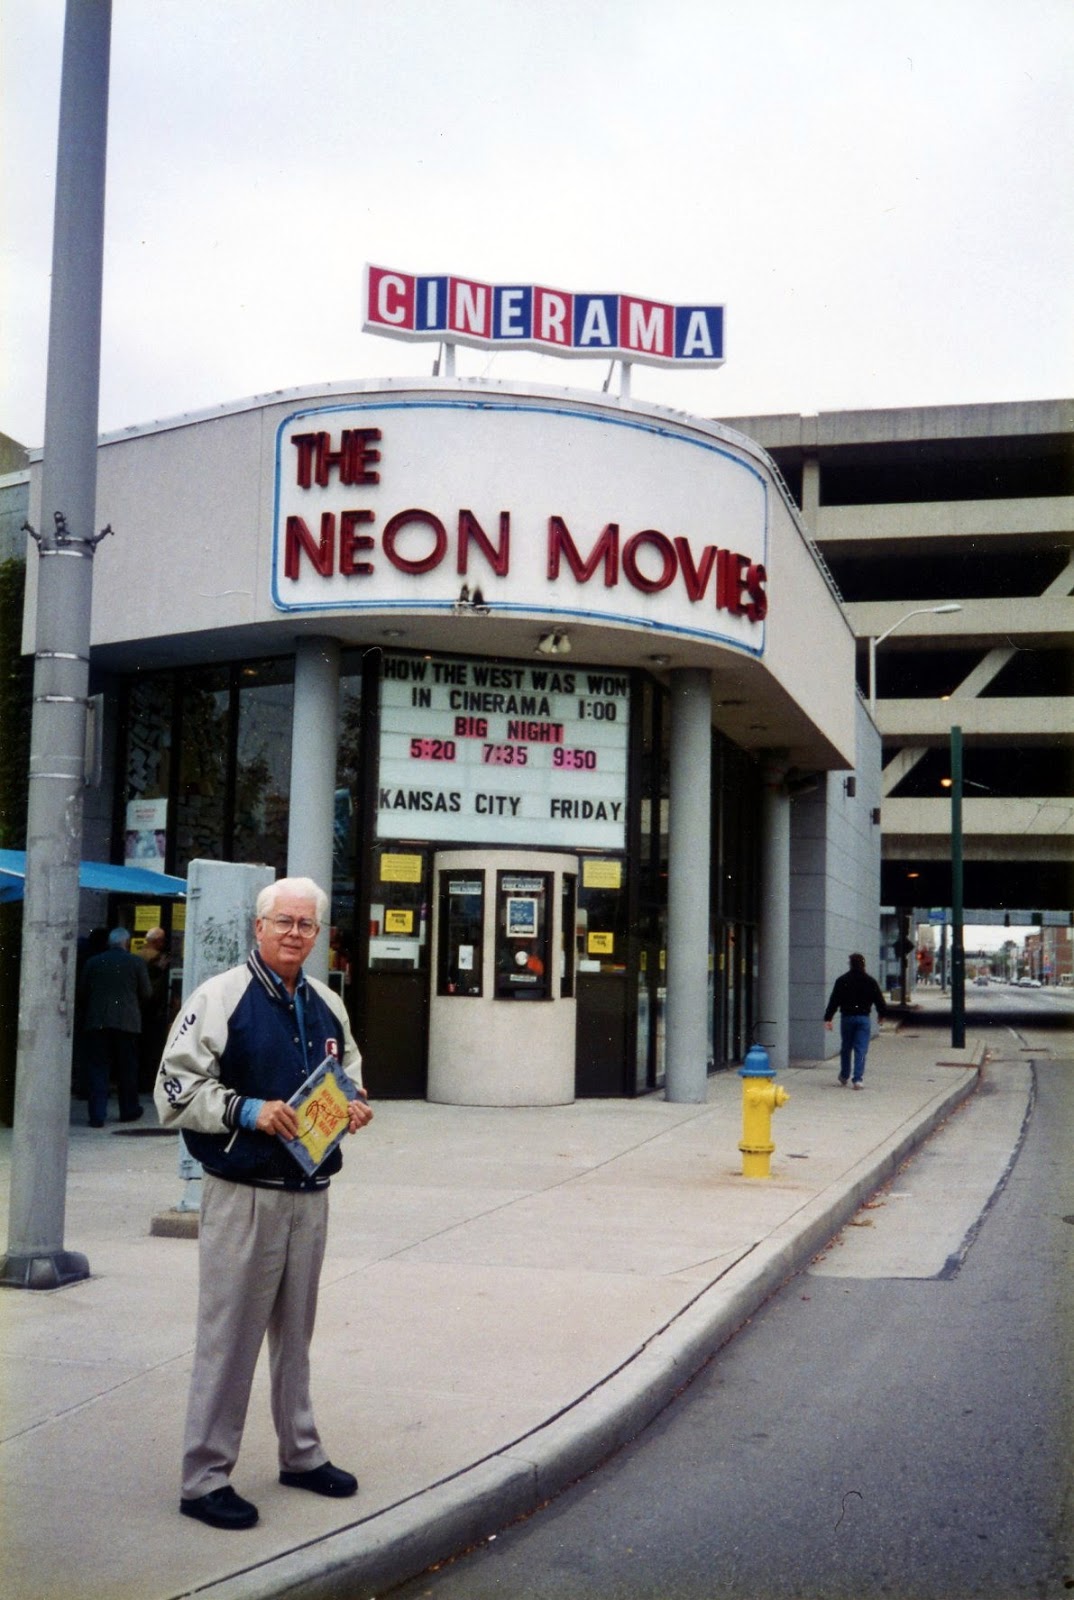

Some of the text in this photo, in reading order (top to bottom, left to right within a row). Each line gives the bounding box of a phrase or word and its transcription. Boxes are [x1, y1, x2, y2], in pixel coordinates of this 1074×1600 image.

[377, 274, 714, 356] CINERAMA
[290, 428, 382, 490] THE
[284, 507, 768, 622] NEON MOVIES
[384, 659, 627, 697] HOW THE WEST WAS WON
[411, 687, 617, 721] IN CINERAMA 1:00
[454, 716, 564, 743] BIG NIGHT
[410, 739, 597, 769] 5:20 7:35 9:50
[379, 788, 622, 821] KANSAS CITY FRIDAY
